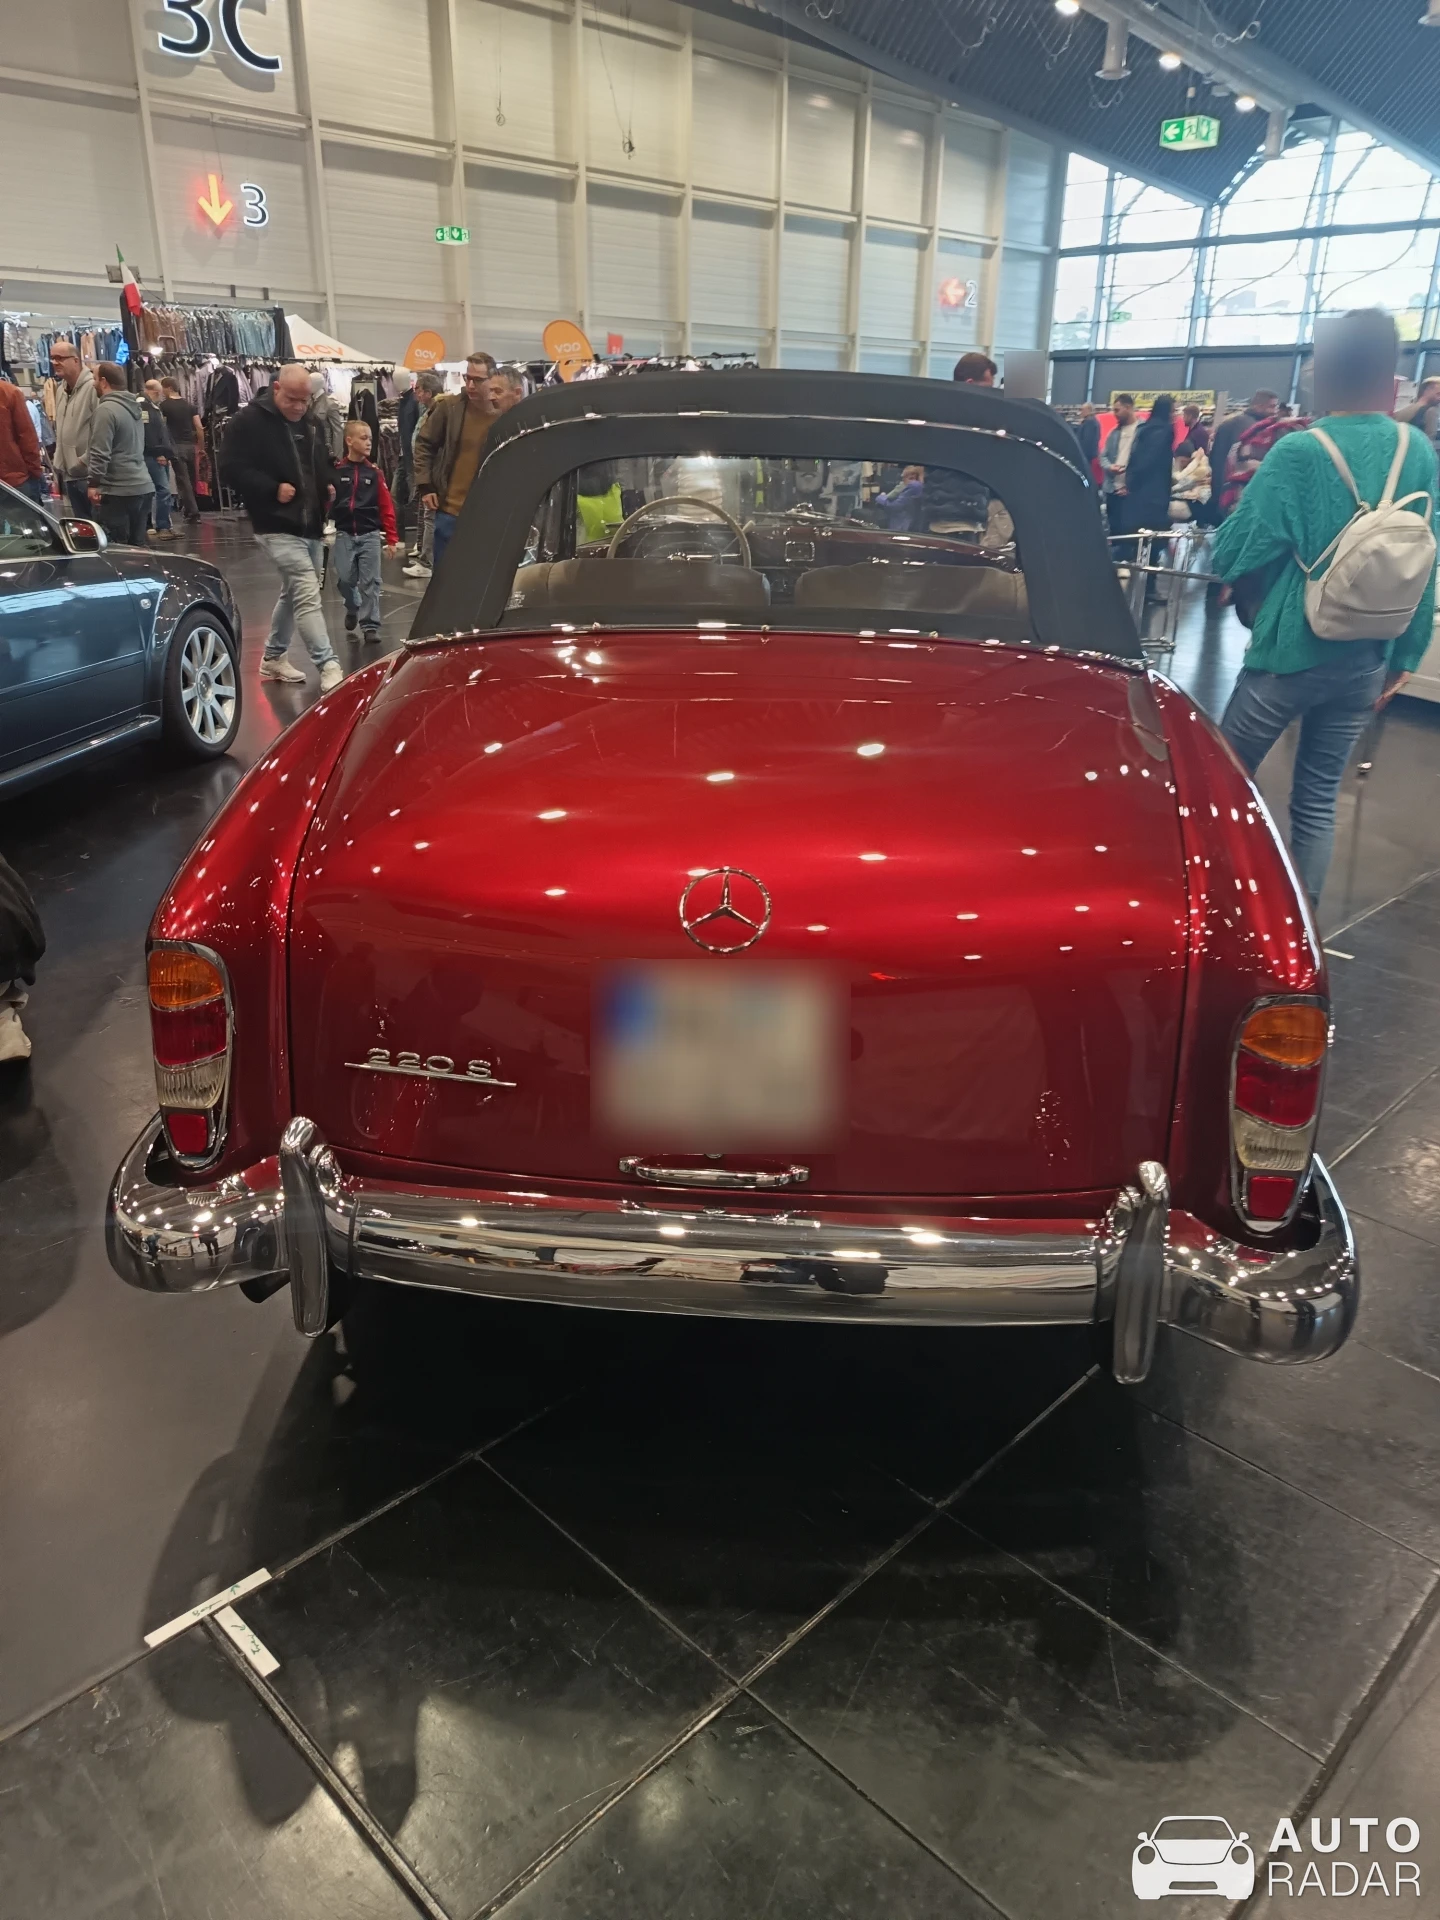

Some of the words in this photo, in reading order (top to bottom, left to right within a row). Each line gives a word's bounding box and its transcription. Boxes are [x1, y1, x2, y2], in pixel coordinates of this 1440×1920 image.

[158, 0, 282, 72] 3C
[240, 182, 269, 227] 3
[964, 279, 978, 308] 2
[415, 348, 437, 360] acv
[367, 1048, 455, 1074] 220
[466, 1059, 492, 1079] S
